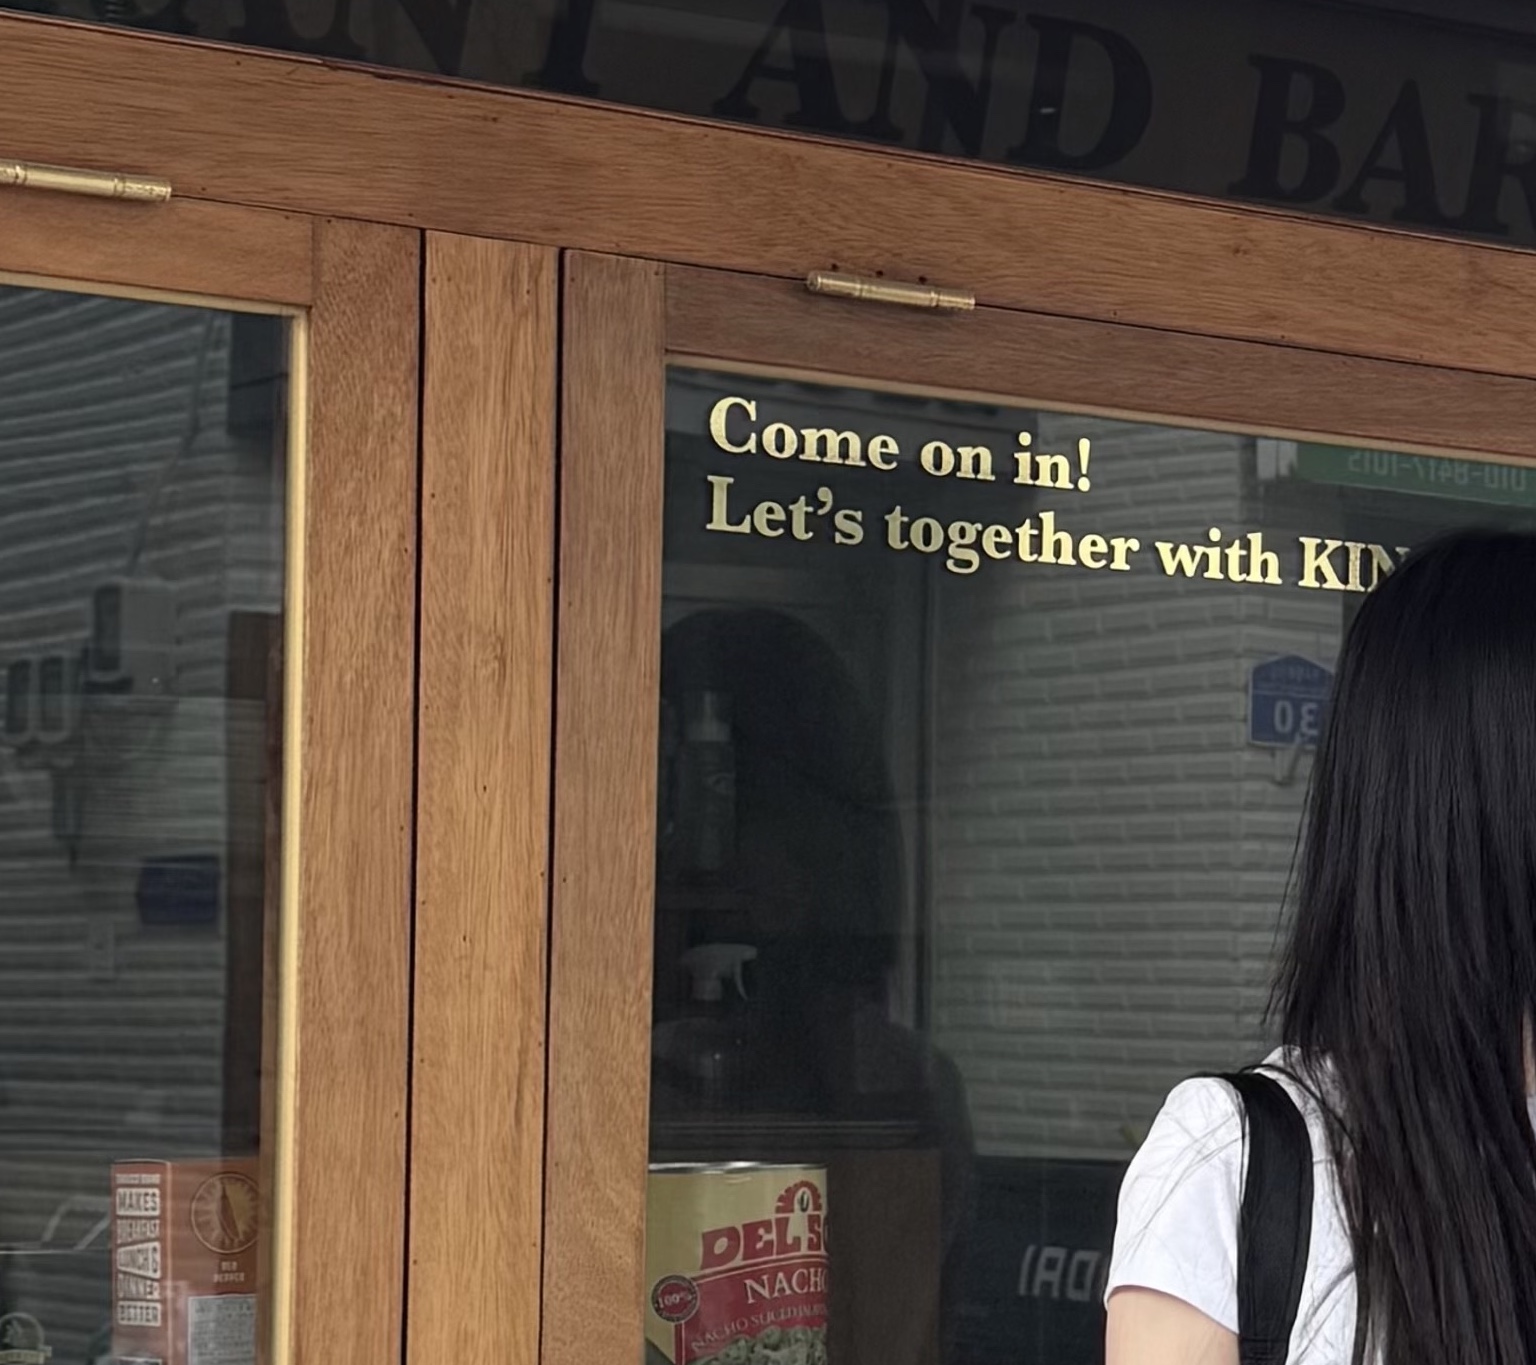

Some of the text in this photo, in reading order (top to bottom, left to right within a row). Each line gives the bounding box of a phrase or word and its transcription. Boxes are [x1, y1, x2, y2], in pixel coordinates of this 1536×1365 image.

[712, 0, 1152, 170] AND
[709, 396, 1090, 492] Come on in!
[706, 475, 1411, 592] Let's together with KIN
[117, 1191, 158, 1213] MAKES
[701, 1213, 829, 1271] DEL S
[690, 1317, 749, 1352] NACHO
